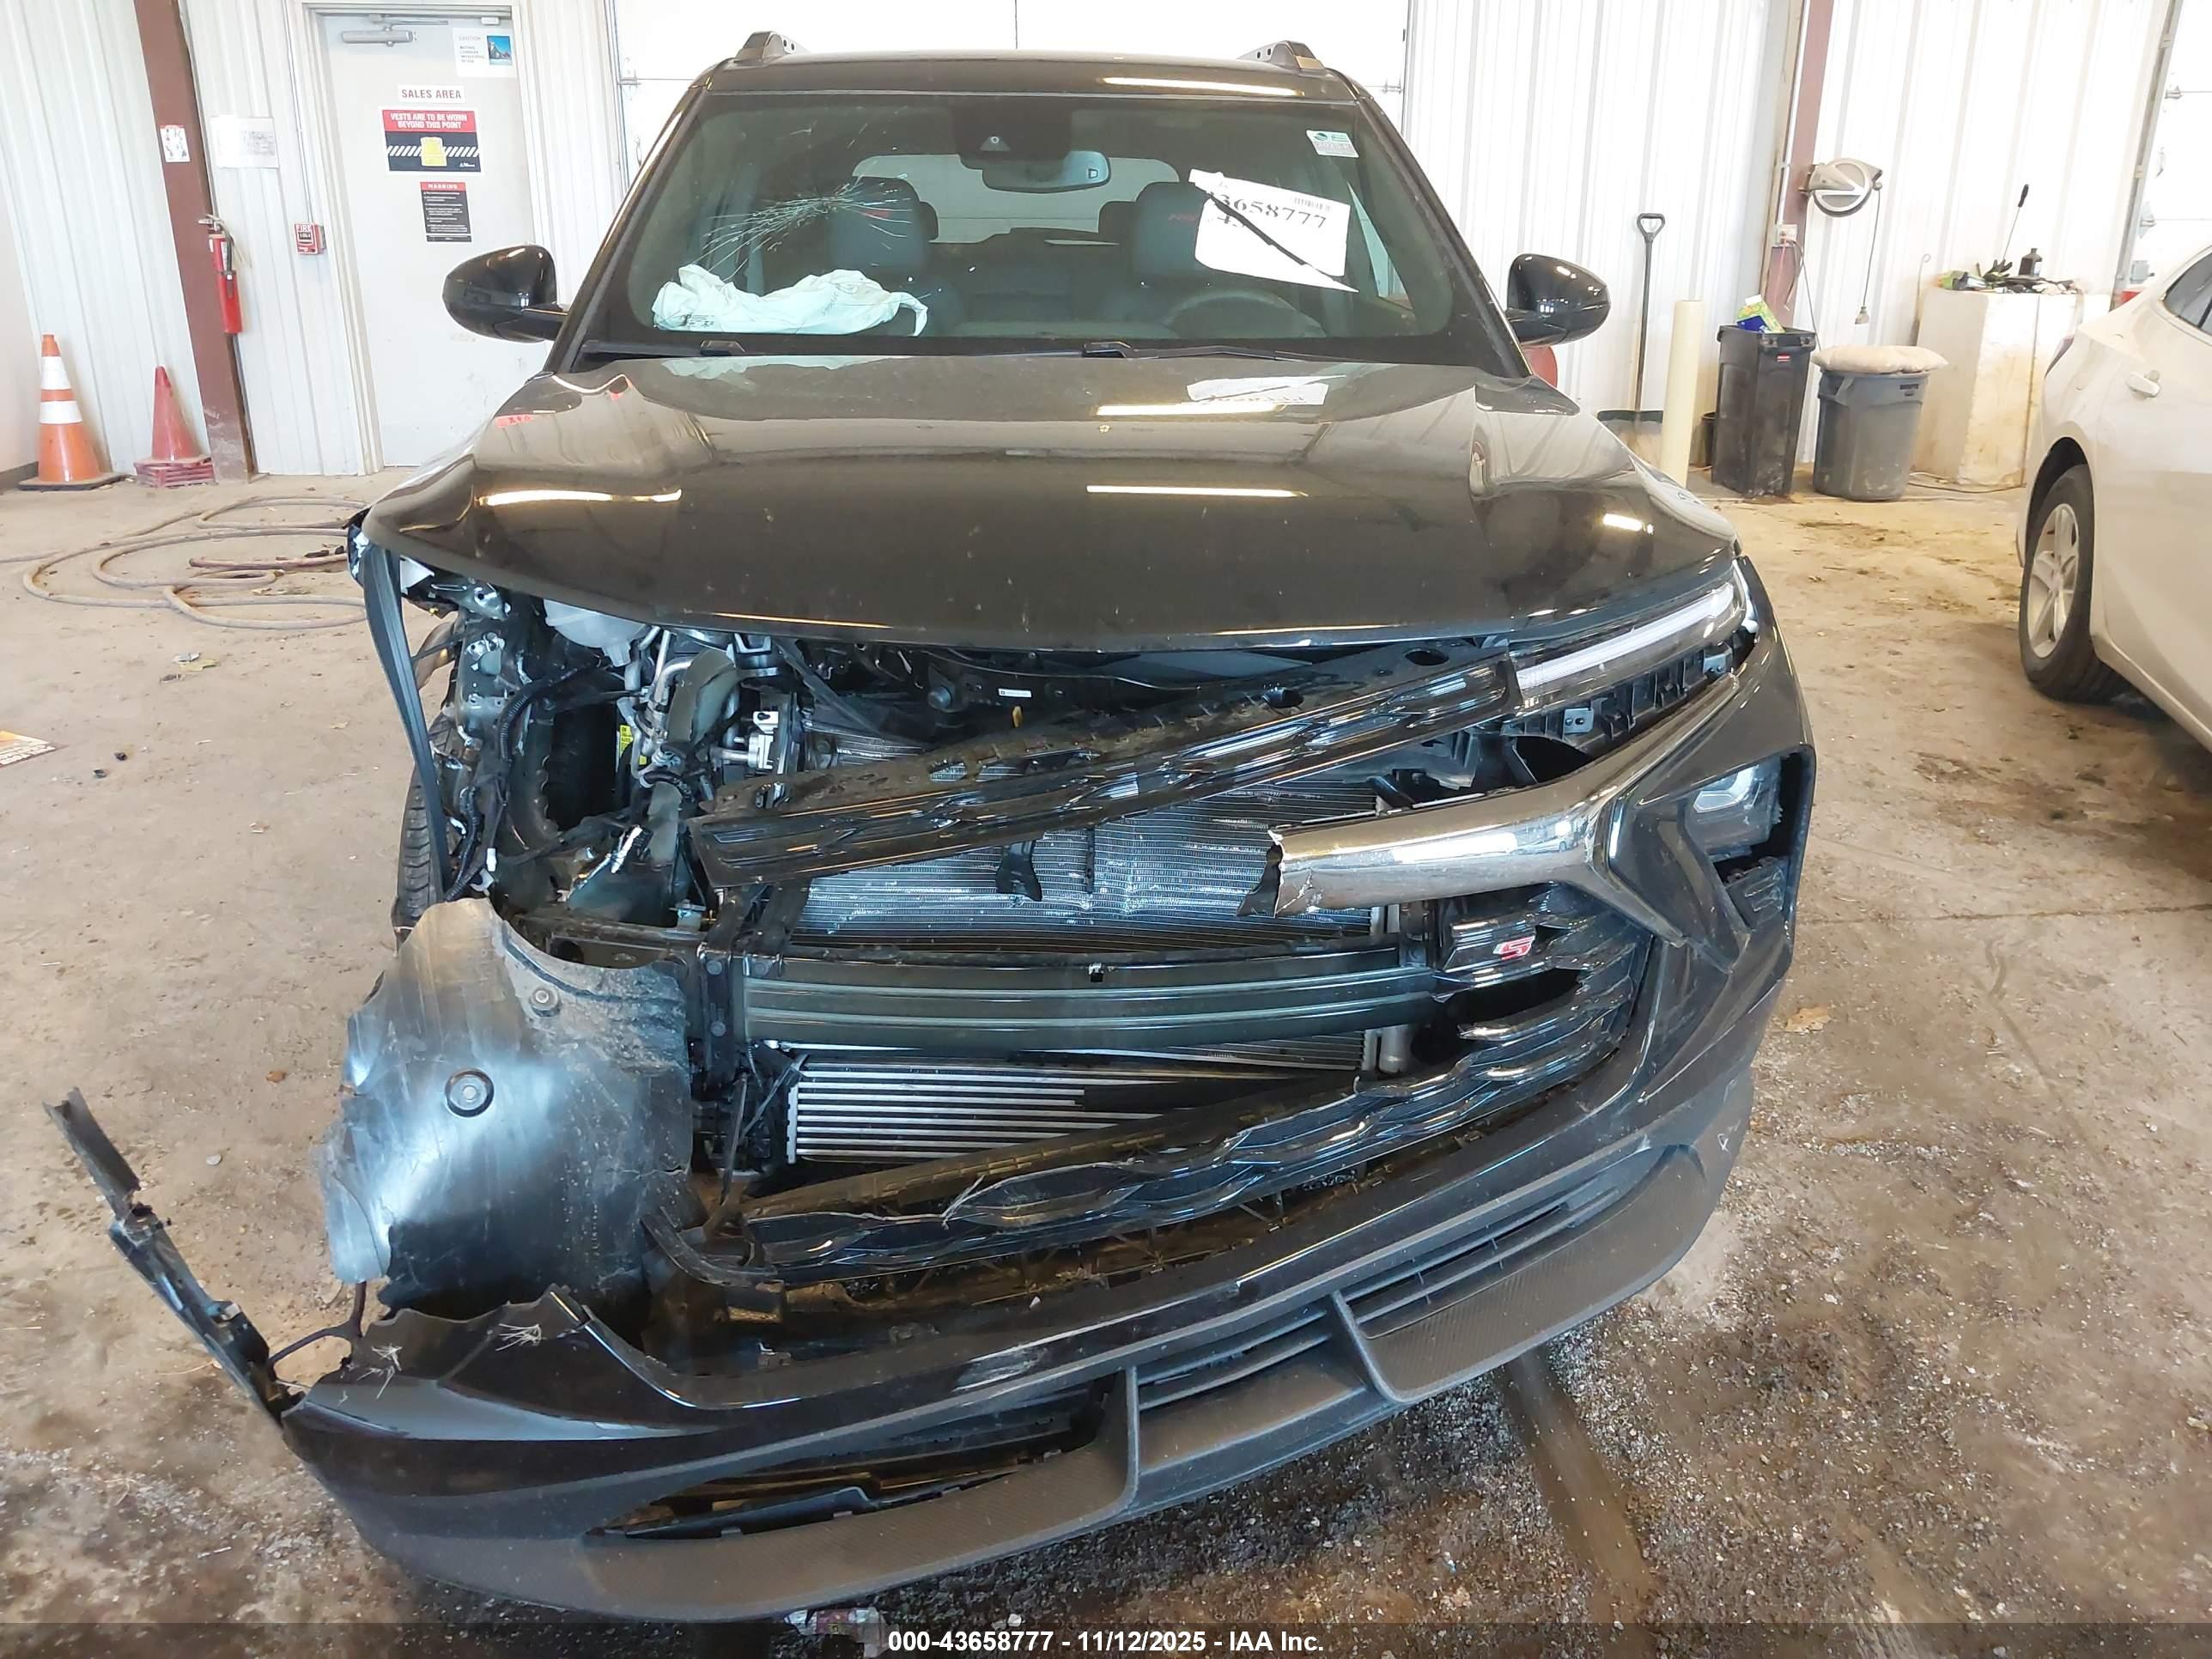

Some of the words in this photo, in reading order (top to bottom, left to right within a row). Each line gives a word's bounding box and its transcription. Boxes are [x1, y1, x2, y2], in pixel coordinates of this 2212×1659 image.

[401, 88, 432, 99] SALES
[435, 89, 462, 99] AREA
[390, 112, 411, 121] VESTS
[412, 112, 426, 121] ARE
[426, 112, 435, 121] TO
[447, 113, 467, 122] WORN
[398, 120, 425, 129] BEYOND
[441, 121, 462, 130] POINT
